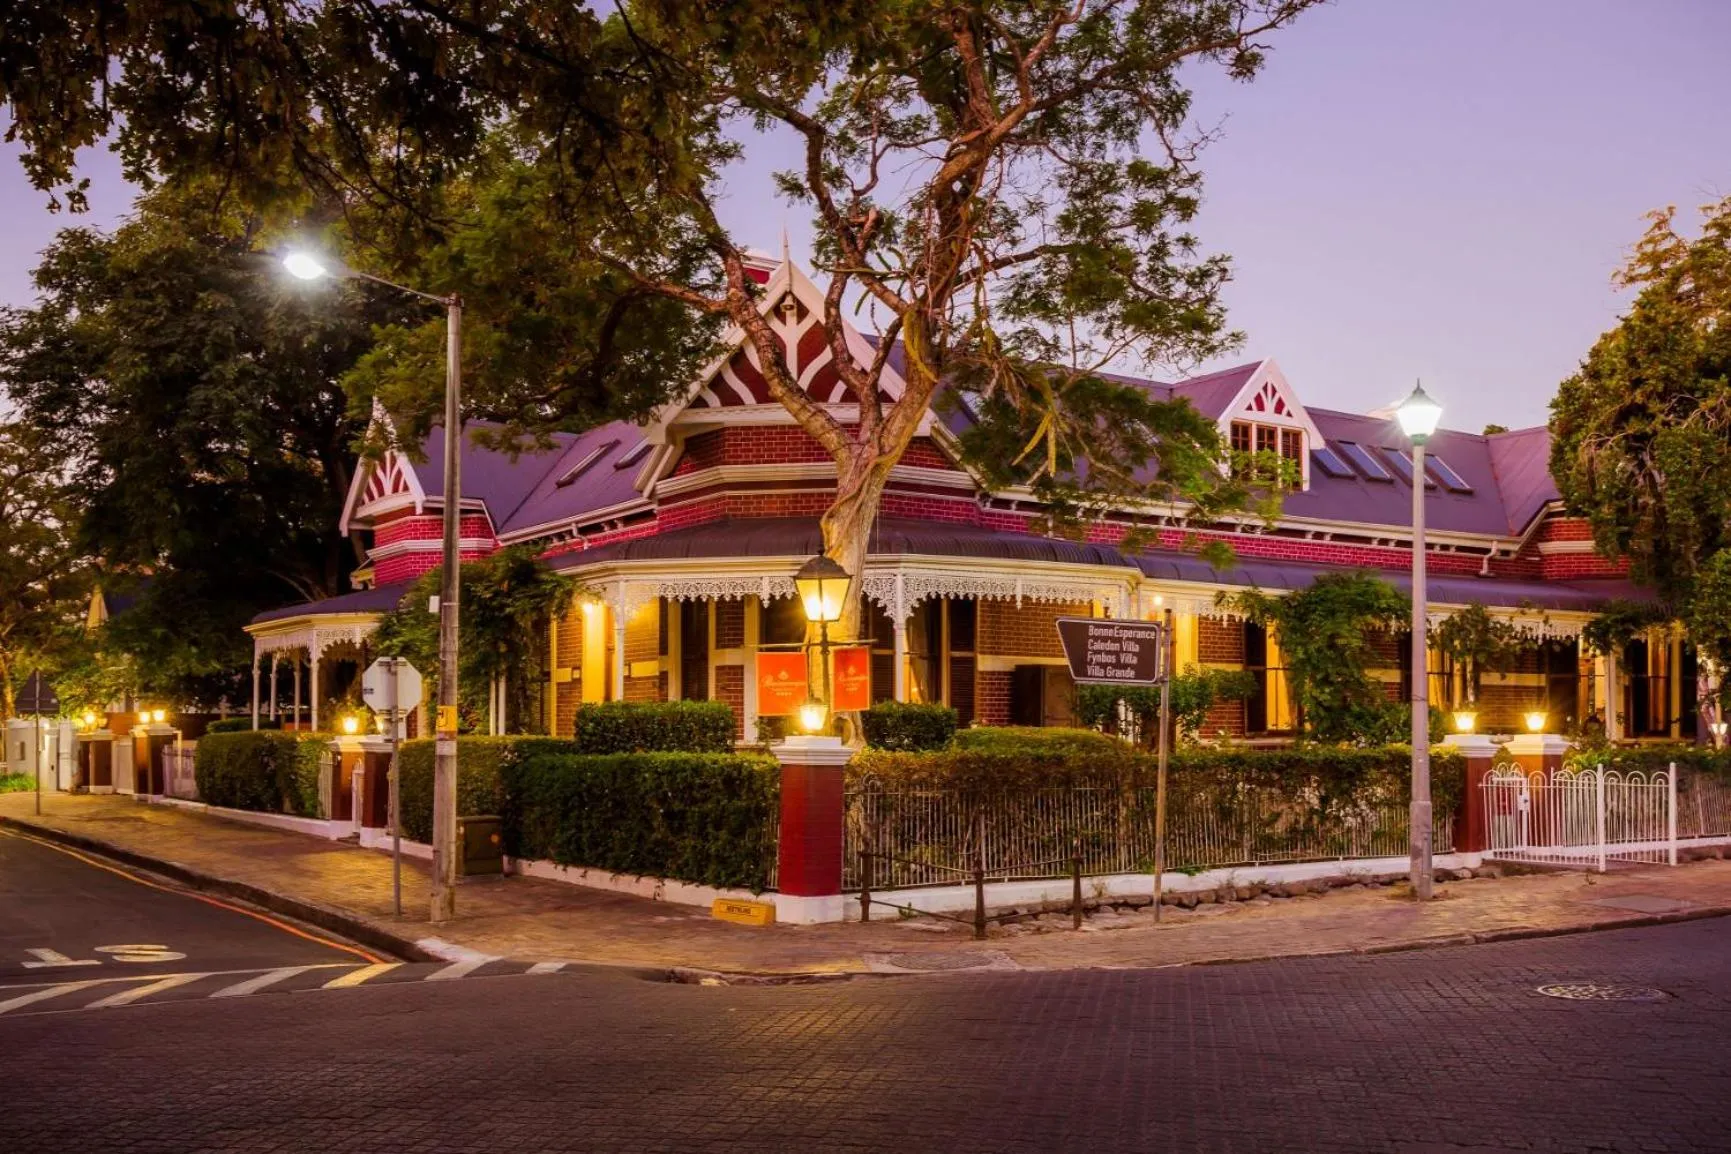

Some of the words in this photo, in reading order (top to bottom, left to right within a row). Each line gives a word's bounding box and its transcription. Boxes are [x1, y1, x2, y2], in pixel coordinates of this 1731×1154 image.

[1088, 625, 1114, 637] Bonne
[1114, 627, 1156, 640] Esperance
[1088, 639, 1120, 651] Caledon
[1122, 640, 1140, 652] Villa
[1087, 652, 1116, 664] Fynbos
[1120, 652, 1138, 664] Villa
[1087, 665, 1104, 677] Villa
[1106, 666, 1135, 678] Grande
